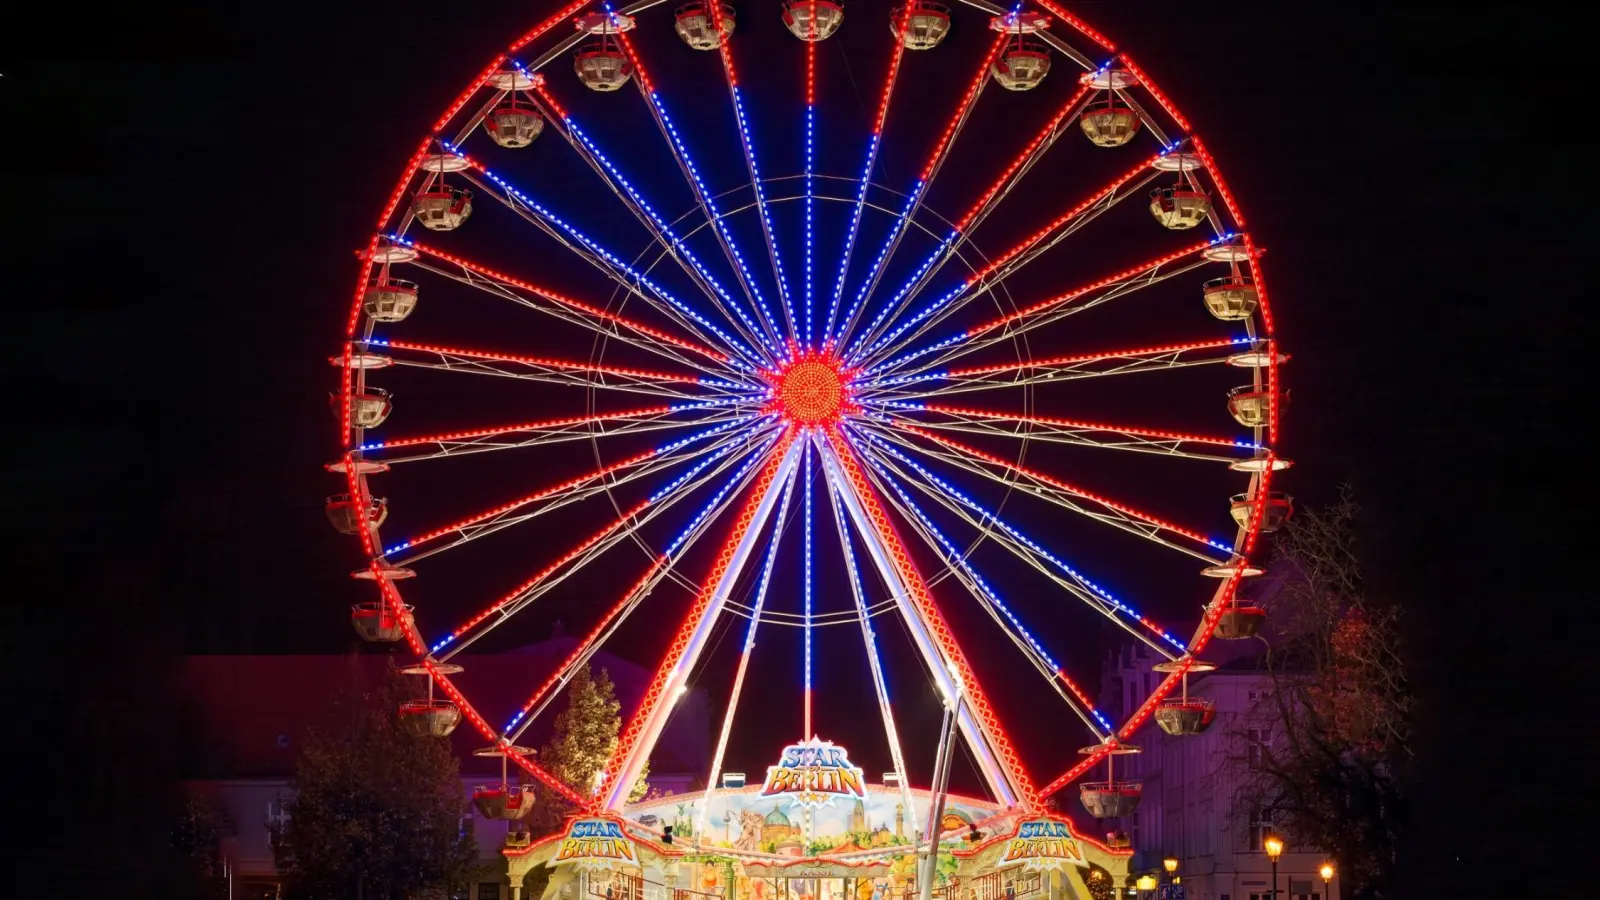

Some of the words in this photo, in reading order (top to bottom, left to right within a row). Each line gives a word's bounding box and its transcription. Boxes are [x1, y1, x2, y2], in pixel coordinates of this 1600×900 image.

[781, 748, 849, 769] STAR
[761, 767, 864, 797] BERLIN
[571, 822, 623, 838] STAR
[1019, 822, 1070, 838] STAR
[556, 838, 632, 861] BERLIN
[1004, 838, 1081, 861] BERLIN
